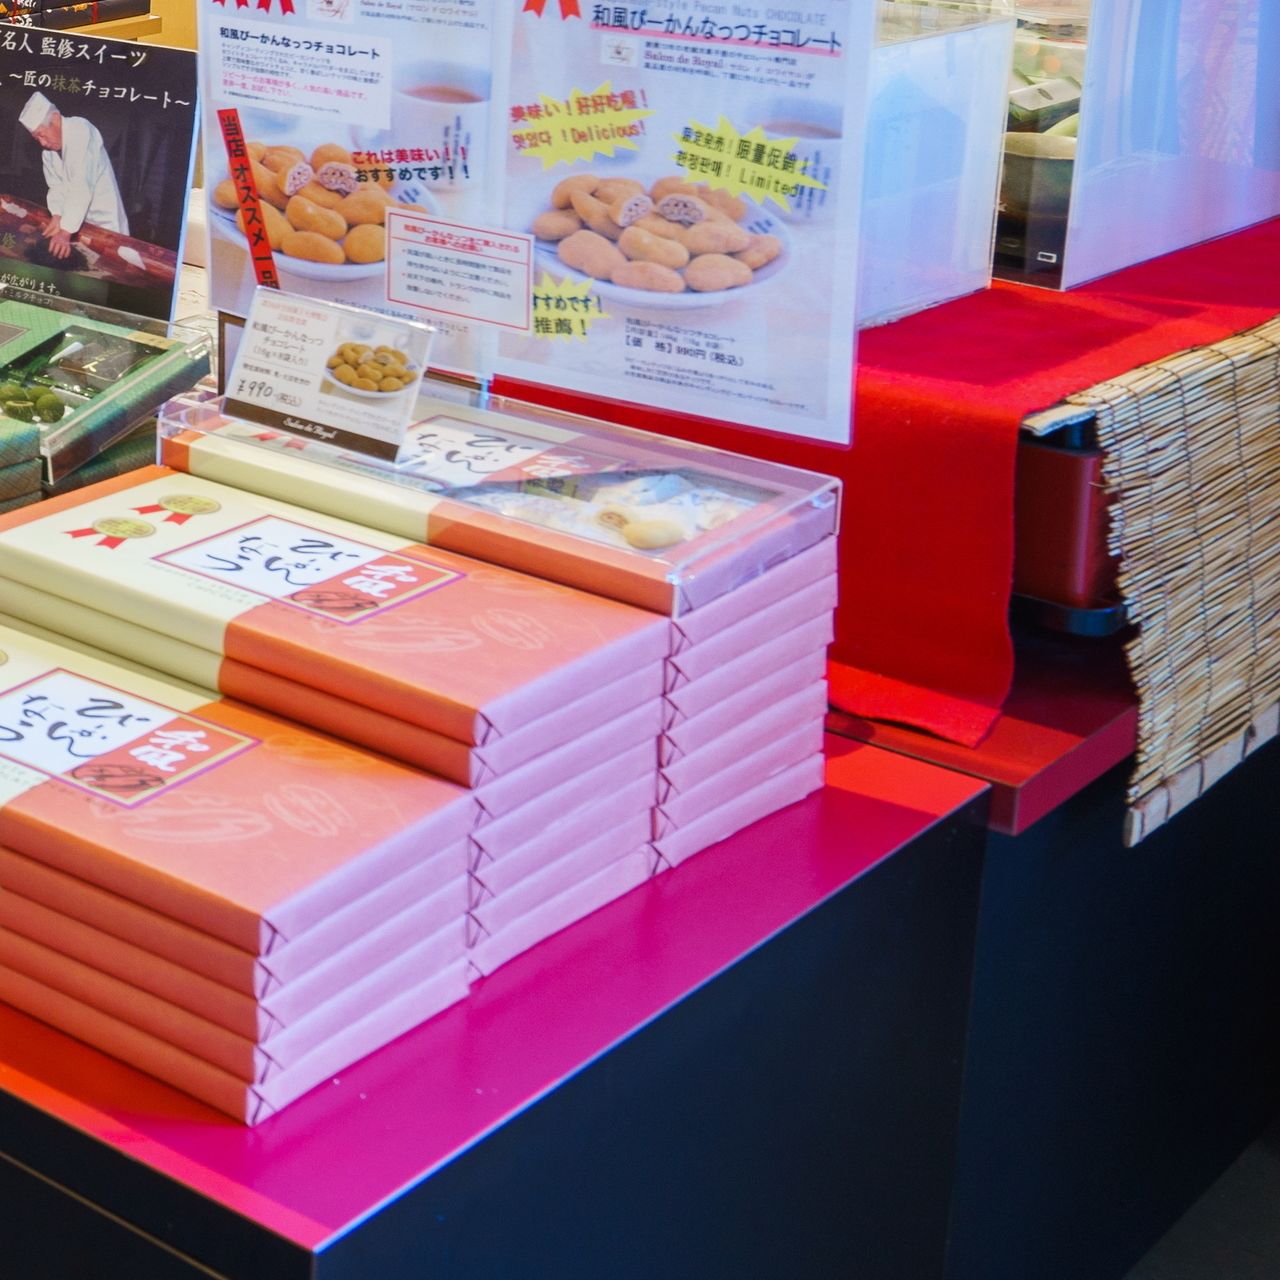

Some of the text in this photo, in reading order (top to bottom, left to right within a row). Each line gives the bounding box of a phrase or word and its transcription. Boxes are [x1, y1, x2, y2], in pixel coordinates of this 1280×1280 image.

[40, 36, 148, 68] 監修スイーツ
